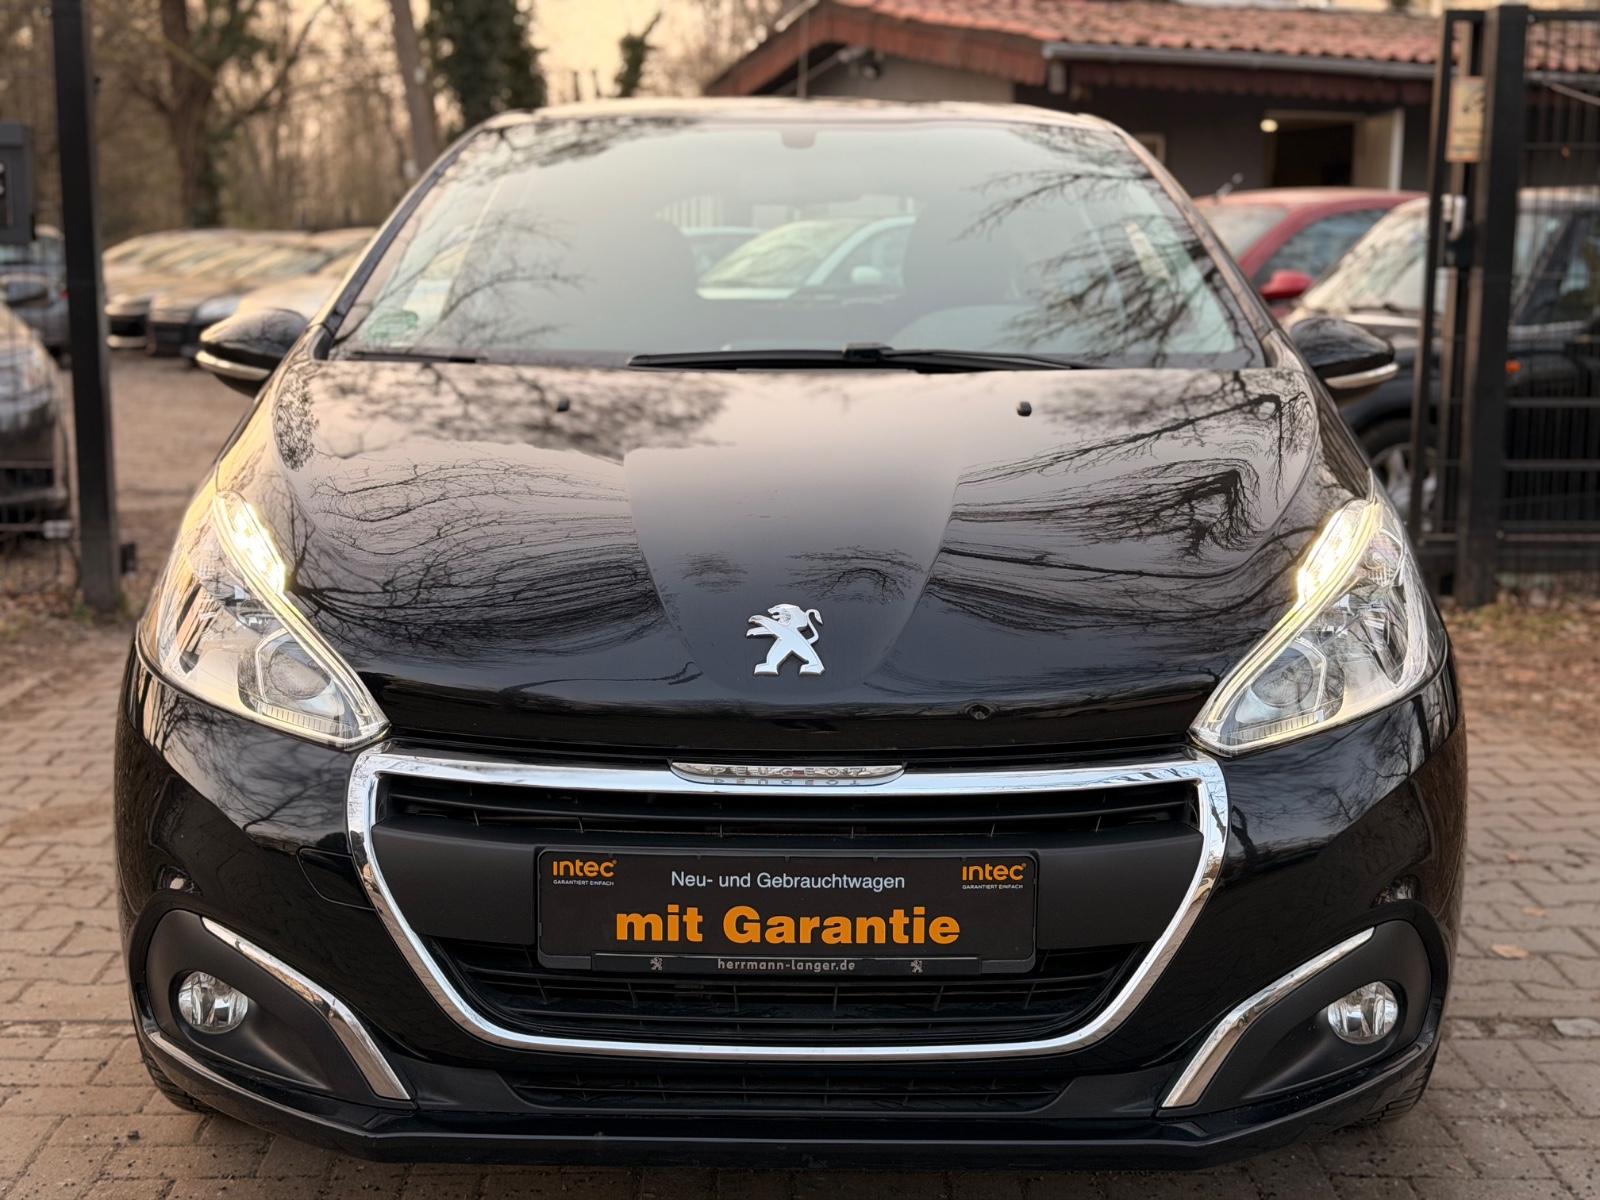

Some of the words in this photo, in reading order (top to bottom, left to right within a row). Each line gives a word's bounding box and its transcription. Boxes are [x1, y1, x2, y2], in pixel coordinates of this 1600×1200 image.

[552, 859, 615, 878] intec
[962, 863, 1024, 881] intec
[671, 871, 713, 887] Neu-
[718, 872, 751, 888] und
[756, 872, 906, 893] Gebrauchtwagen
[616, 903, 704, 942] mit
[722, 905, 961, 944] Garantie
[717, 957, 856, 973] herrmann-langer.de
